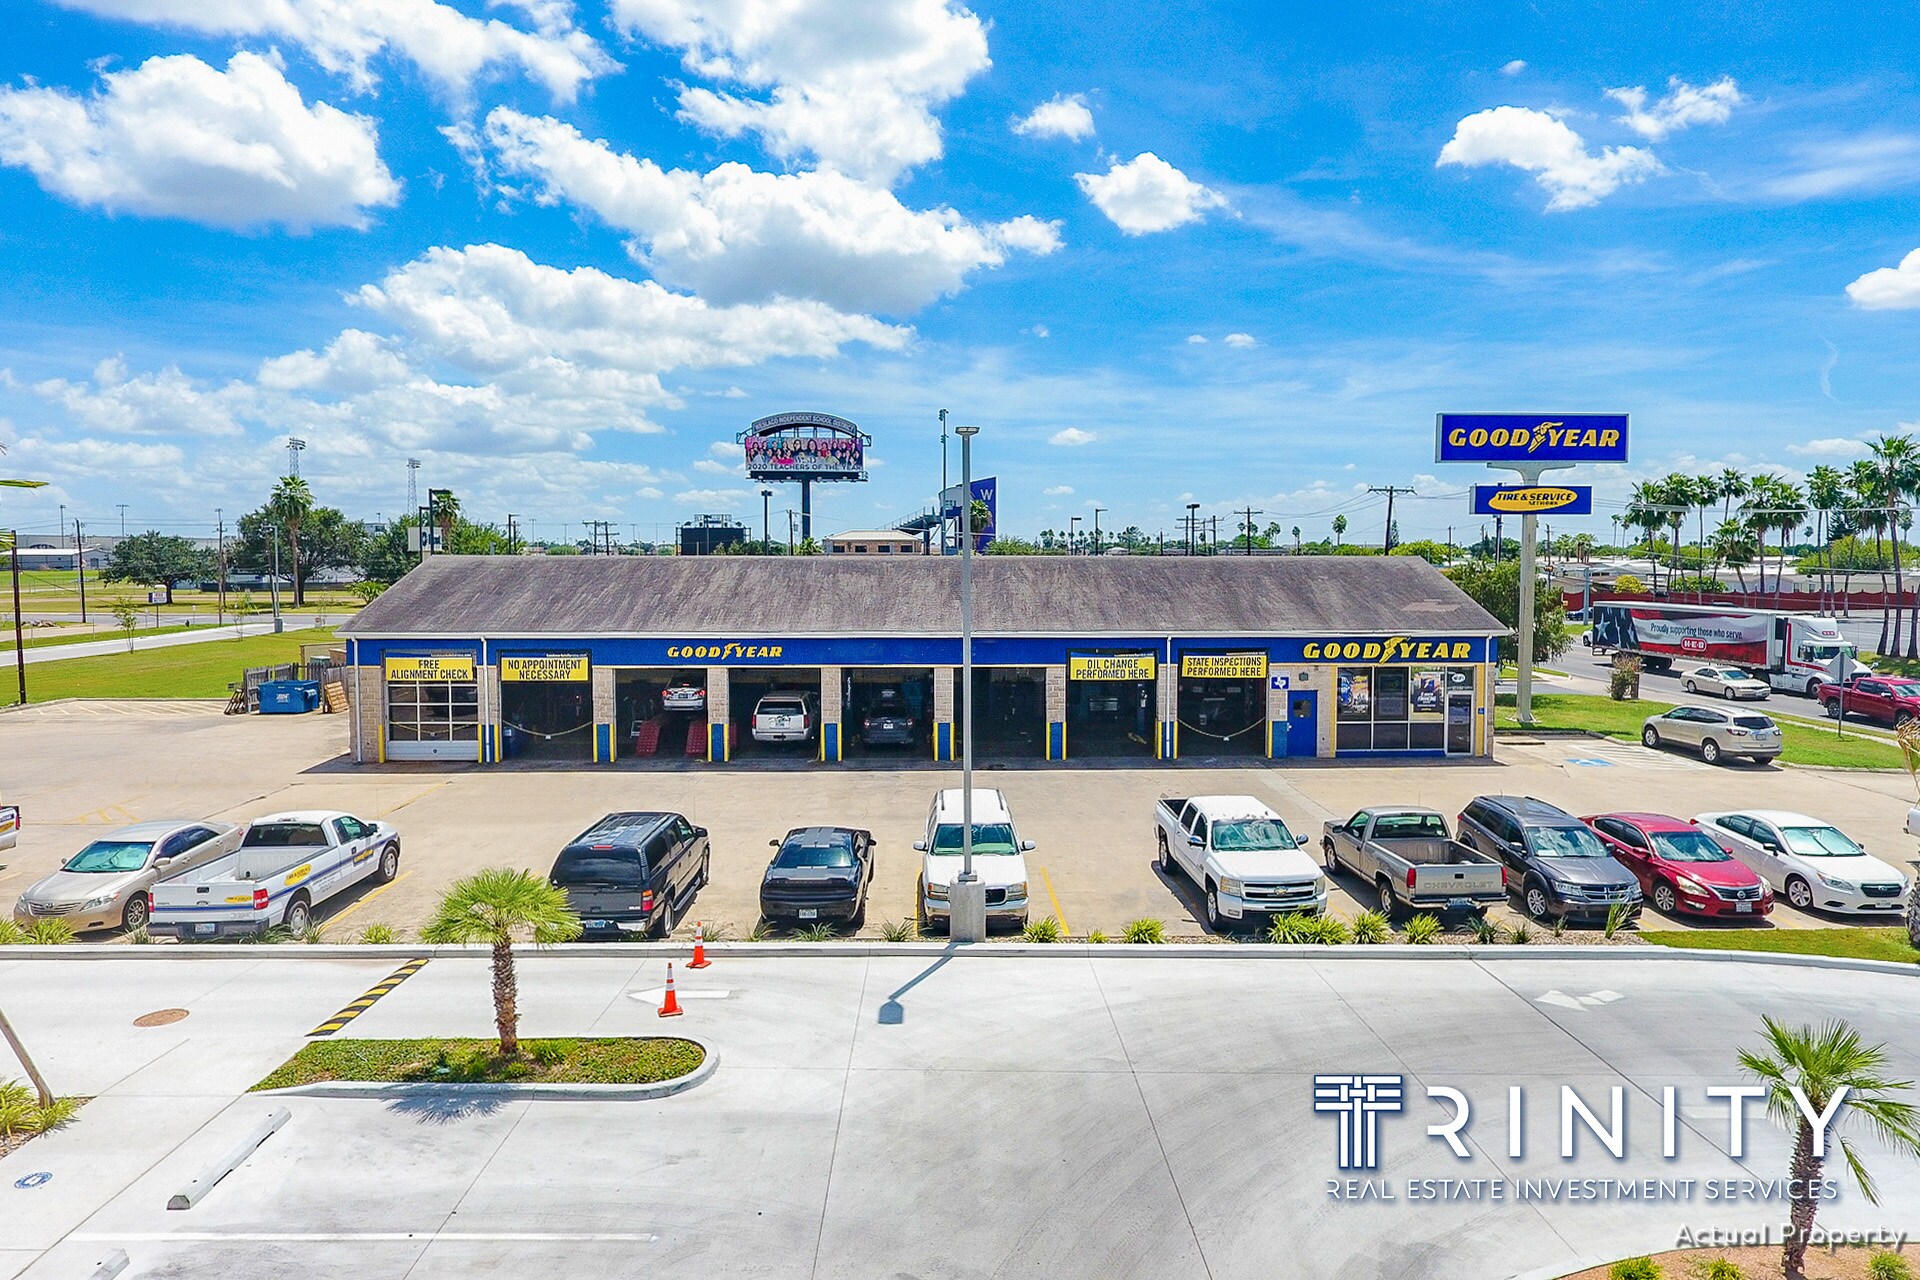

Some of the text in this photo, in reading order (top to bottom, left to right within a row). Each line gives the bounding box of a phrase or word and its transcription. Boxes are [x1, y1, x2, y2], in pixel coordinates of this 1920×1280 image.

[1448, 425, 1620, 449] GOODYEAR
[980, 488, 993, 500] W
[1498, 493, 1573, 501] TIRE & SERVICE
[1650, 622, 1669, 634] Proudly
[1669, 626, 1697, 637] supporting
[1697, 626, 1713, 637] those
[1713, 629, 1726, 638] who
[667, 645, 783, 659] GOODYEAR
[1303, 641, 1471, 660] GOODYEAR
[418, 659, 440, 669] FREE
[508, 659, 582, 669] NO APPOINTMENT
[1087, 659, 1139, 669] OIL CHANGE
[1187, 657, 1262, 666] STATE INSPECTIONS
[391, 669, 468, 679] ALIGNMENT CHECK
[519, 670, 571, 679] NECESSARY
[1076, 669, 1149, 679] PERFORMED HERE
[1187, 667, 1262, 676] PERFORMED HERE
[1424, 881, 1494, 889] CHEVROLET
